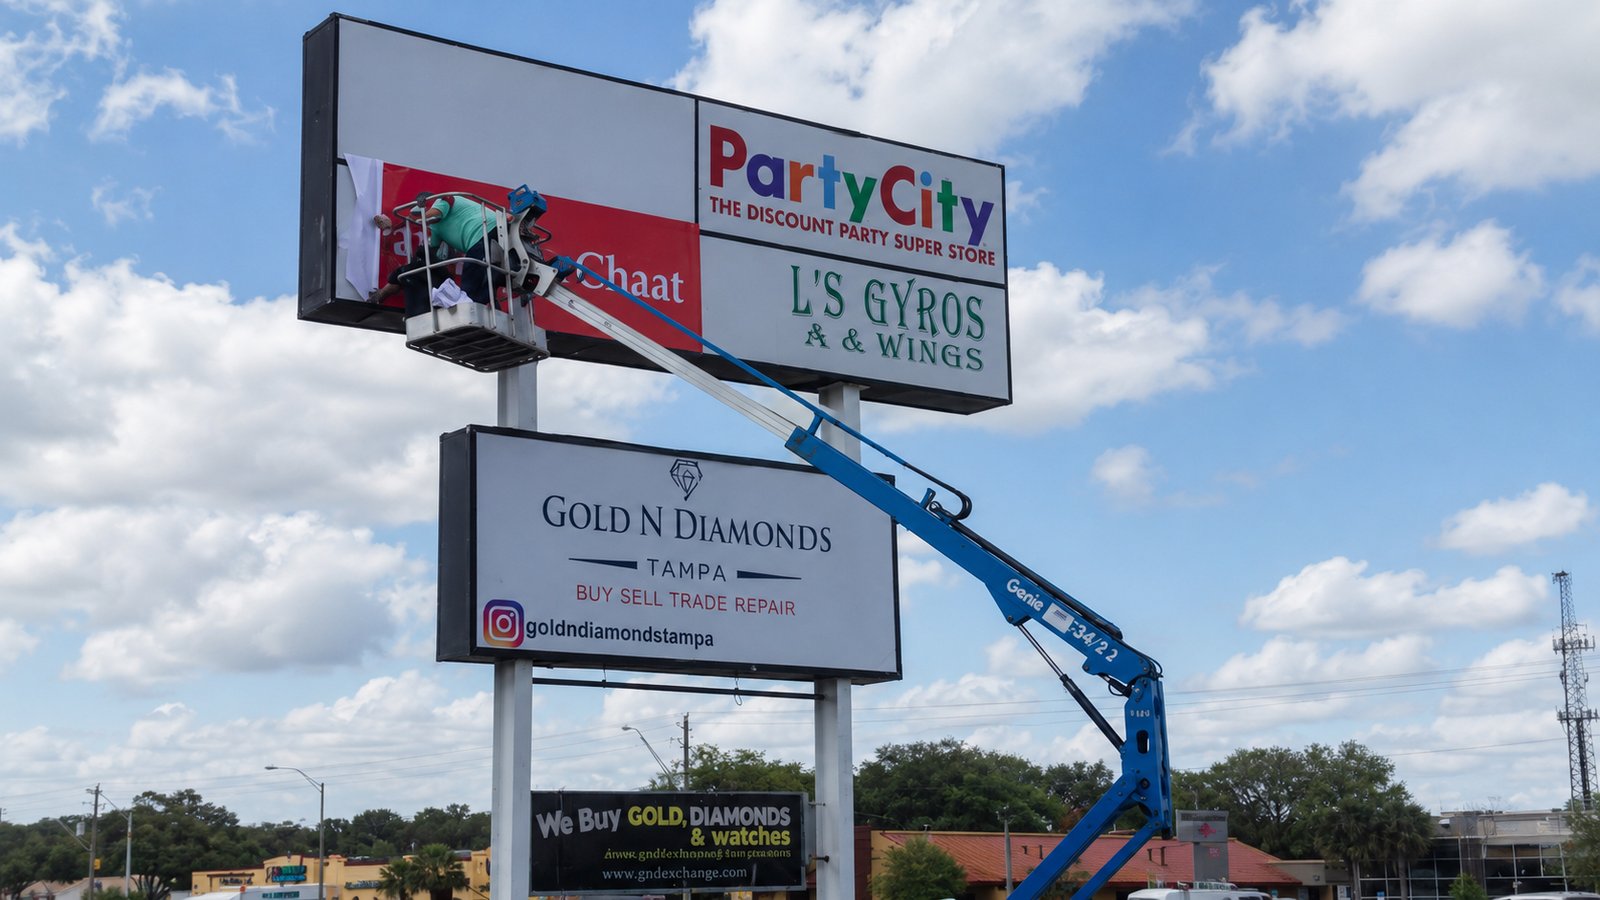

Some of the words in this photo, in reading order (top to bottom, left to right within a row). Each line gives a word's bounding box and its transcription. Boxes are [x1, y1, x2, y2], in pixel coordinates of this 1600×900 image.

[710, 196, 741, 218] THE
[747, 204, 834, 236] DISCOUNT
[839, 222, 889, 246] PARTY
[894, 233, 943, 257] SUPER
[948, 244, 996, 267] STORE
[576, 251, 684, 304] Chaat
[790, 264, 845, 319] L'S
[864, 277, 985, 342] GYROS
[842, 328, 866, 353] &
[876, 332, 984, 372] WINGS
[542, 494, 631, 535] GOLD
[640, 504, 664, 537] N
[674, 507, 833, 553] DIAMONDS
[646, 557, 728, 583] TAMPA
[576, 583, 613, 604] BUY
[620, 588, 664, 608] SELL
[668, 591, 729, 613] TRADE
[735, 597, 796, 617] REPAIR
[1006, 578, 1044, 612] Genie
[525, 618, 714, 650] goldndiamondstampa
[536, 810, 574, 839] We
[578, 807, 622, 833] Buy
[627, 806, 687, 828] GOLD,
[689, 806, 792, 827] DIAMONDS
[690, 827, 706, 847] &
[711, 826, 792, 847] watches
[602, 865, 748, 883] www.gndexchange.com
